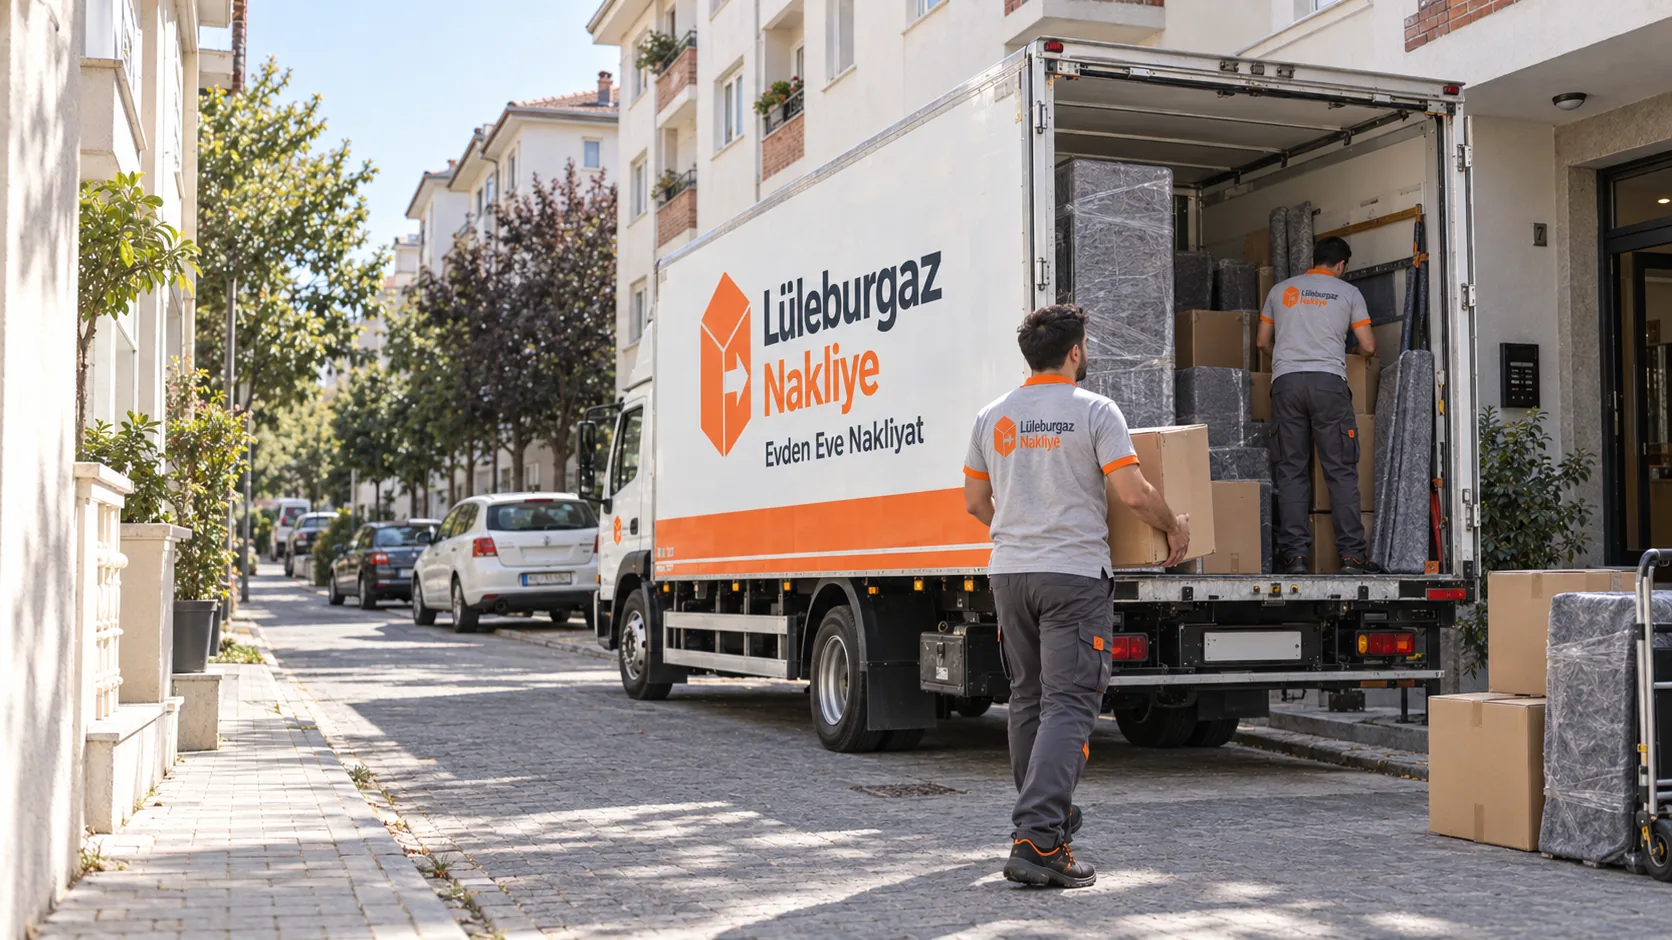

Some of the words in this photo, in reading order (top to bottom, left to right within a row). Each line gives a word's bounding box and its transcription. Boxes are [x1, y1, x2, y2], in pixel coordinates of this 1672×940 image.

[1536, 226, 1544, 241] 7
[763, 250, 943, 347] Lüleburgaz
[763, 342, 880, 417] Nakliye
[765, 437, 811, 468] Evden
[815, 431, 845, 460] Eve
[849, 415, 925, 455] Nakliyat
[1019, 434, 1061, 452] Nakliye
[1020, 419, 1075, 434] Lüleburgaz
